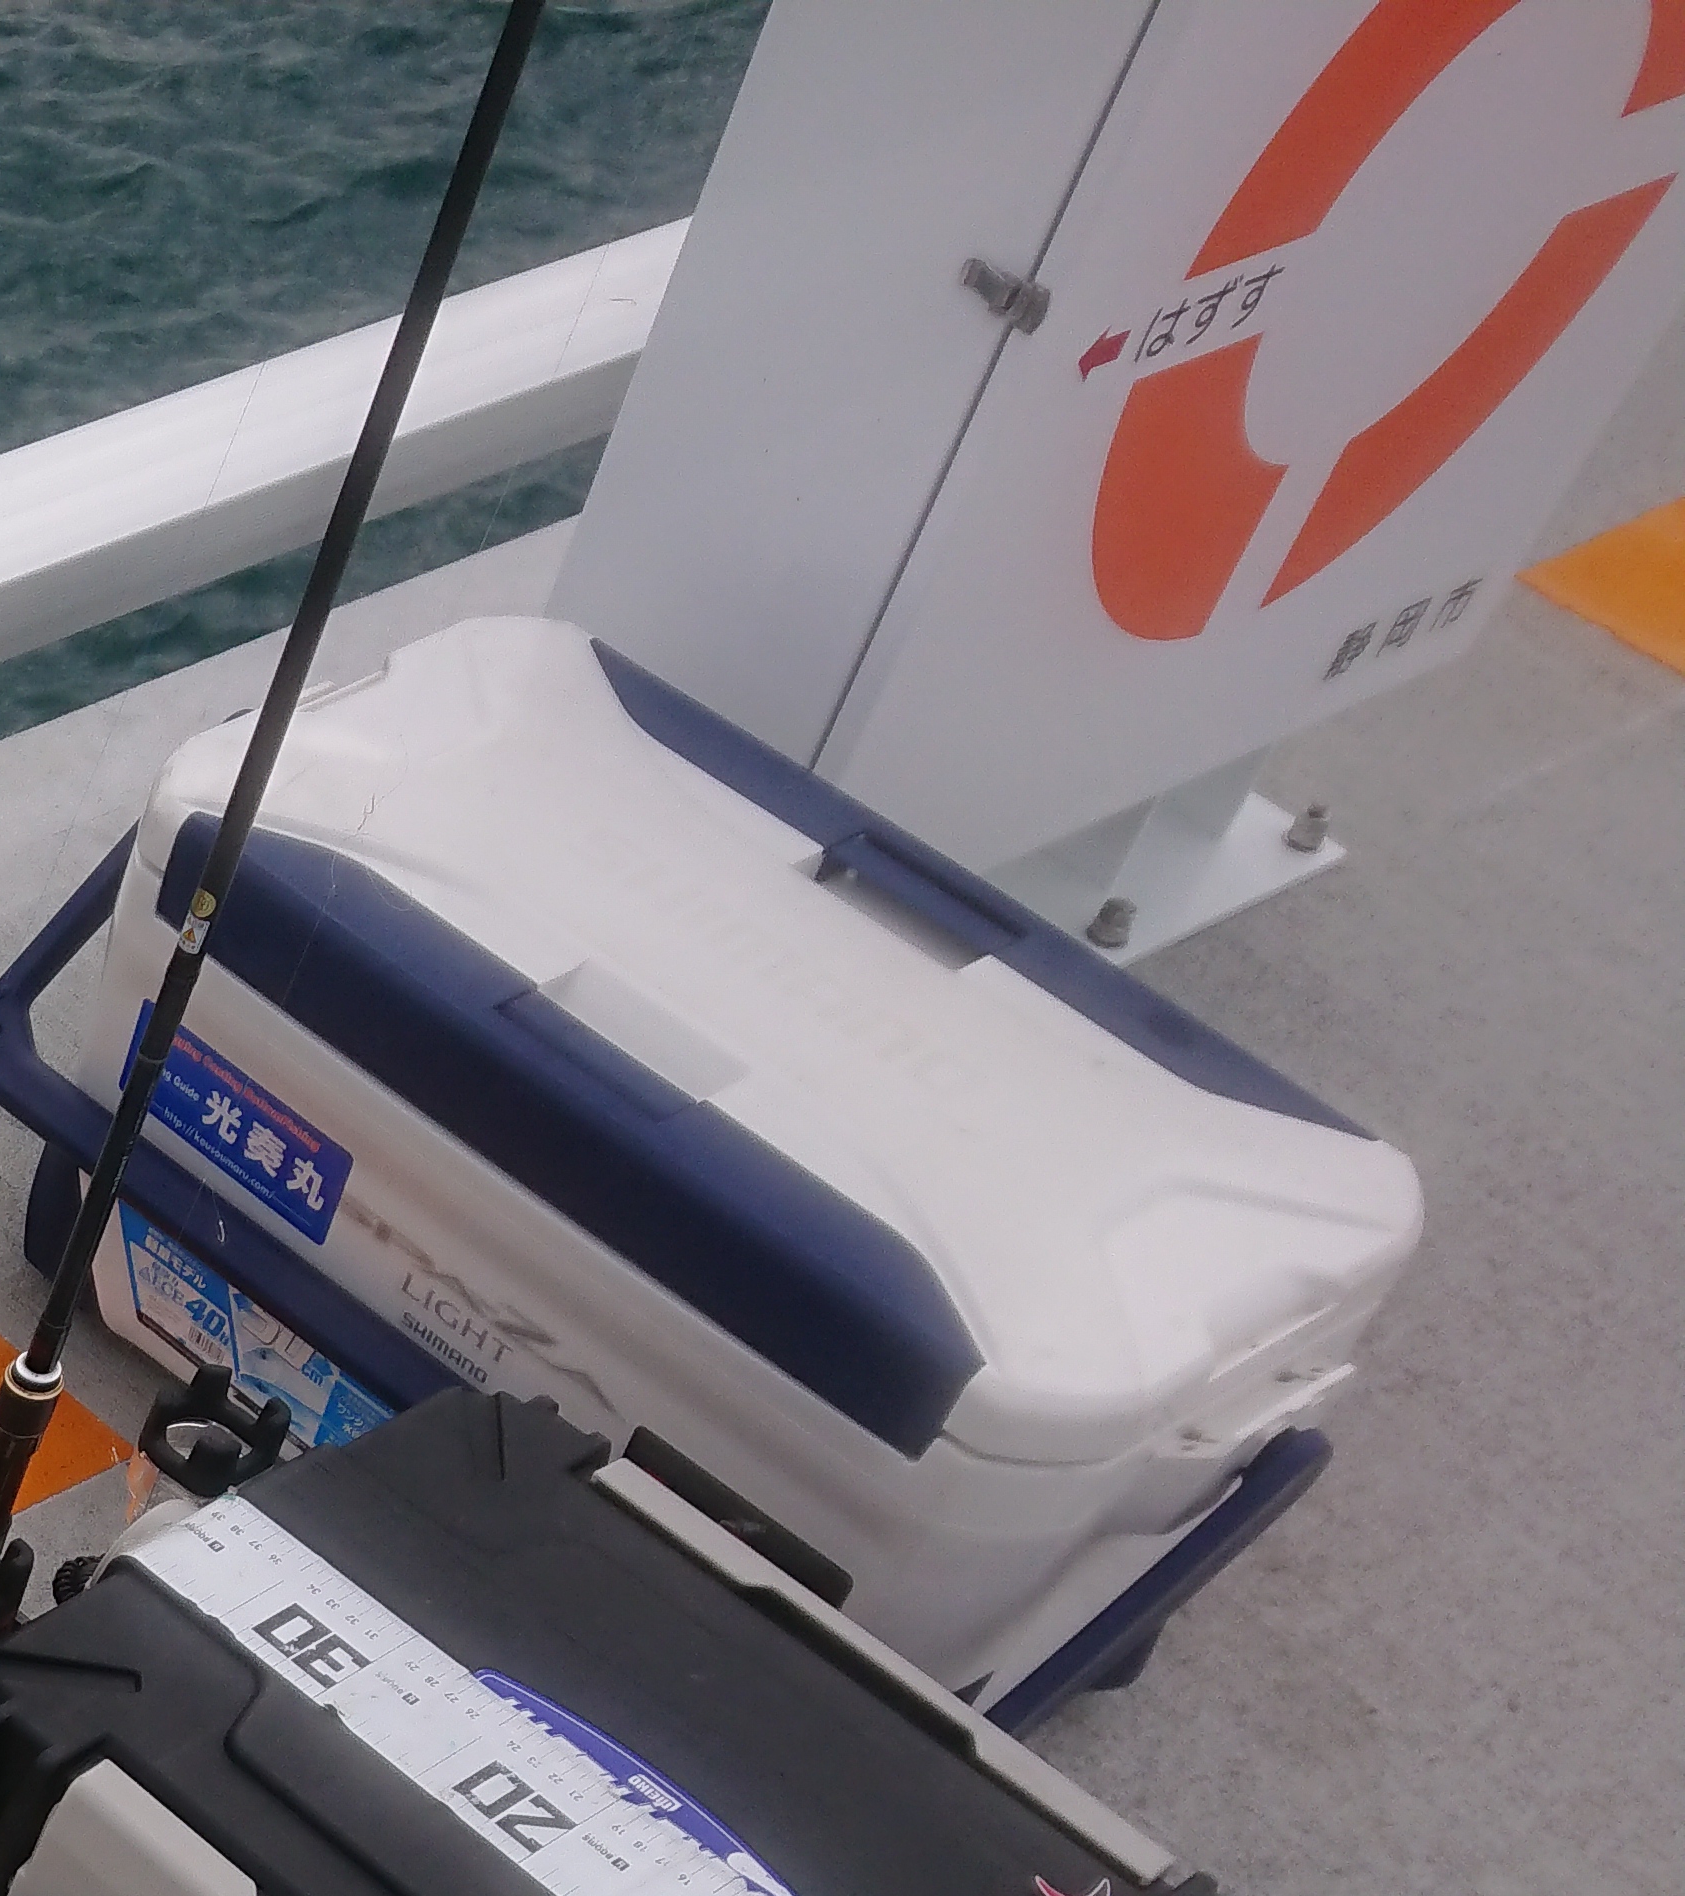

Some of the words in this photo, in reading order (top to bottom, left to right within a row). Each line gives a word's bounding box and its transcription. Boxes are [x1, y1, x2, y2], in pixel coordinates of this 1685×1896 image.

[1134, 264, 1286, 360] はずす
[1323, 578, 1482, 682] 静岡市
[202, 1090, 324, 1211] 光奏丸
[401, 1272, 514, 1363] LIGHT
[401, 1311, 489, 1384] SHIMANO
[249, 1539, 263, 1550] 37
[365, 1629, 378, 1640] 31
[252, 1603, 372, 1689] 30
[405, 1661, 420, 1672] 29
[444, 1692, 459, 1703] 27
[465, 1708, 480, 1719] 26
[507, 1740, 521, 1752] 24
[548, 1773, 563, 1785] 22
[569, 1791, 583, 1802] 21
[452, 1760, 578, 1854] 20
[611, 1824, 626, 1835] 19
[633, 1841, 647, 1852] 18
[678, 1874, 690, 1885] 16
